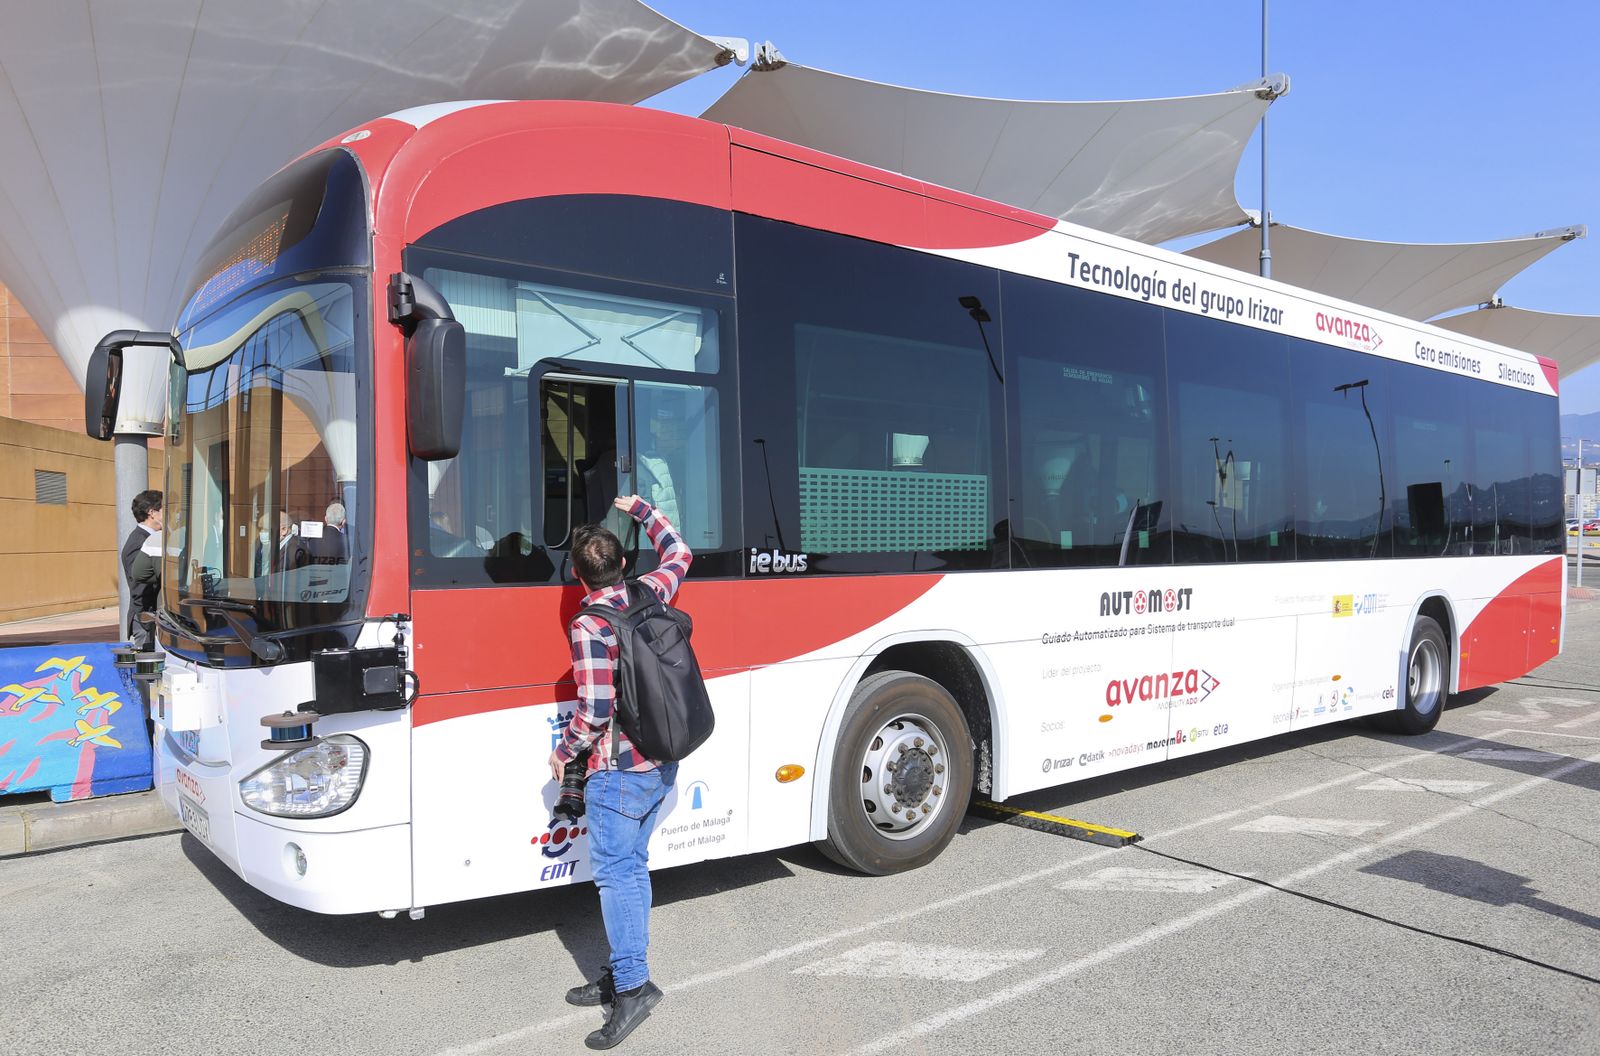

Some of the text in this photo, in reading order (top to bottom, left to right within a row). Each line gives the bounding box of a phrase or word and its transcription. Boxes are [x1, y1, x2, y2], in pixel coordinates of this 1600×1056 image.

[1068, 252, 1284, 326] Tecnología del grupo Irizar
[1316, 312, 1370, 342] avanza
[1415, 340, 1481, 374] Cero emisiones
[1498, 362, 1535, 386] Silencioso
[1100, 587, 1193, 617] AUTOMOST
[1041, 616, 1236, 645] Guiado Automatizado para Sistema de transporte dual
[1106, 668, 1198, 708] avanza
[1053, 757, 1075, 770] Irizar
[1213, 723, 1229, 736] etra
[661, 814, 731, 838] Puerto de Málaga
[668, 833, 726, 852] Port of Málaga
[540, 859, 580, 882] EMT
